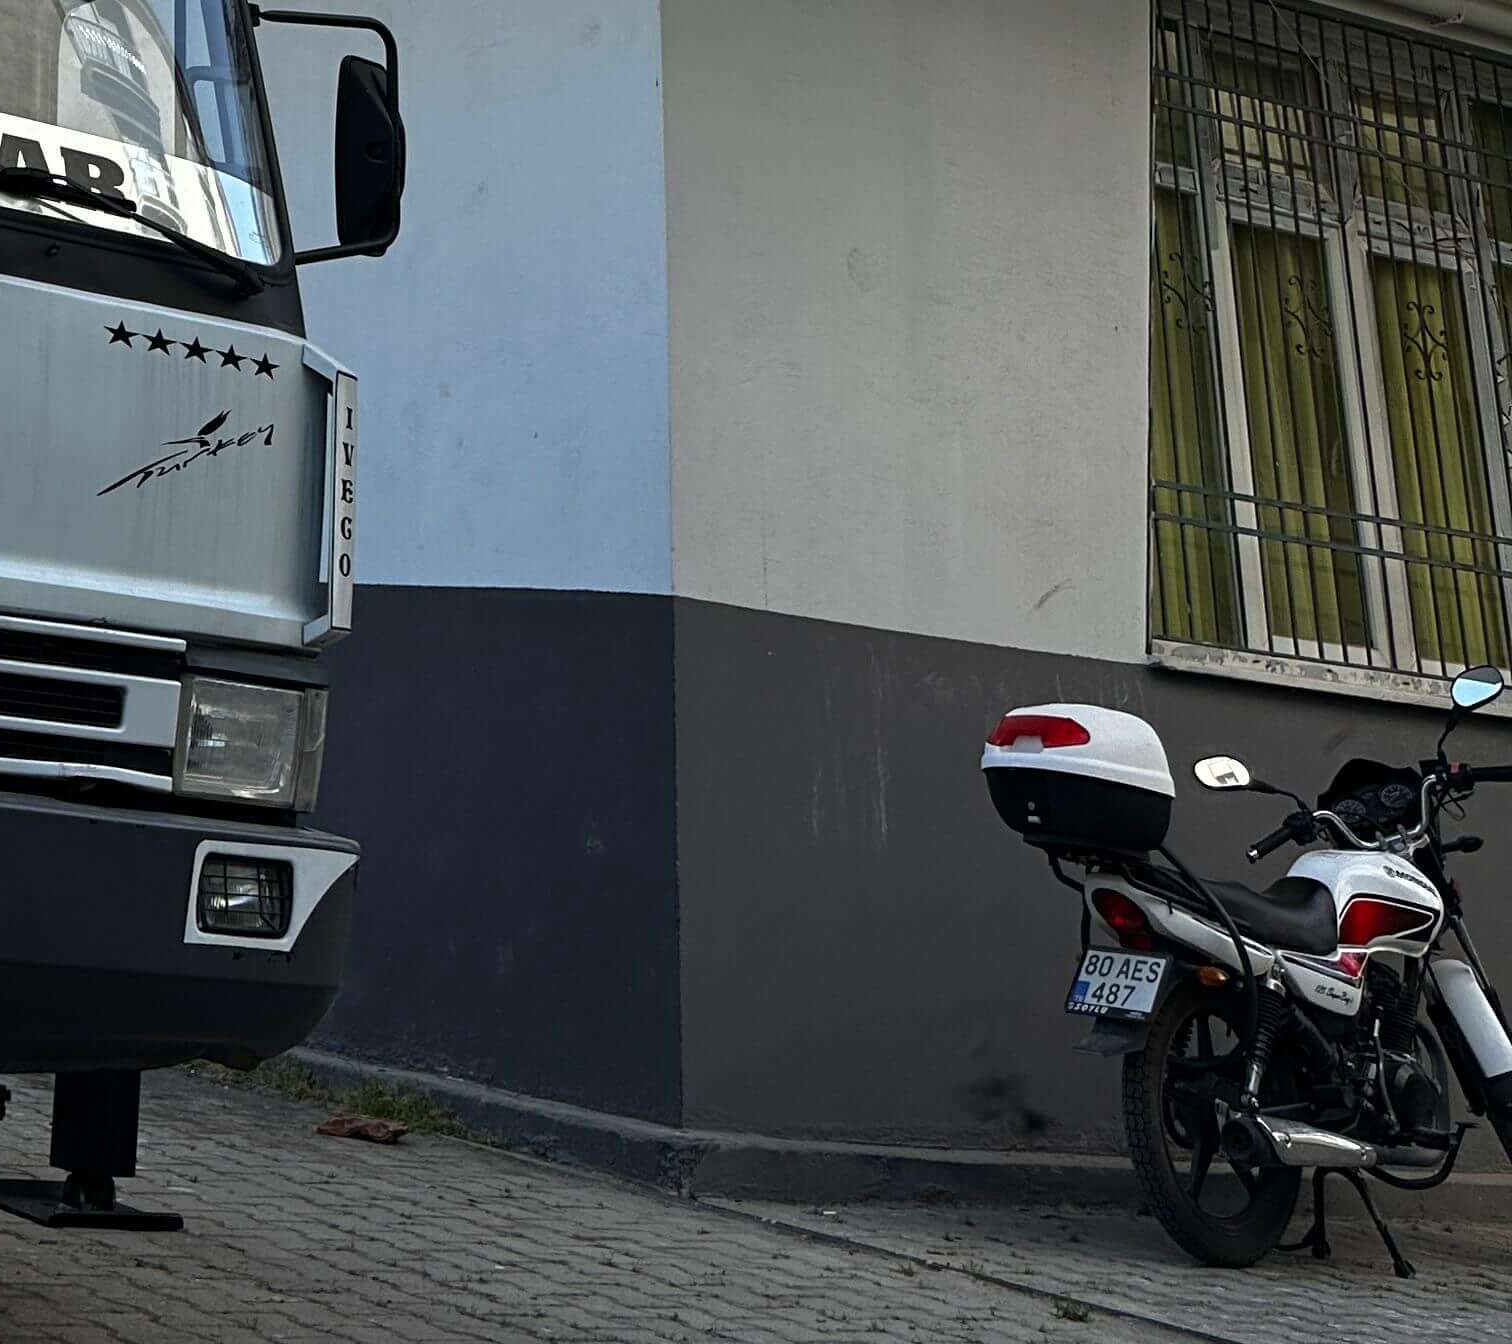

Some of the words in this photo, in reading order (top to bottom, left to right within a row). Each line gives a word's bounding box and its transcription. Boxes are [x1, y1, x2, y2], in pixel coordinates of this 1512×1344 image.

[1085, 954, 1114, 977] 80
[1116, 958, 1161, 983] AES
[1091, 982, 1136, 1007] 487
